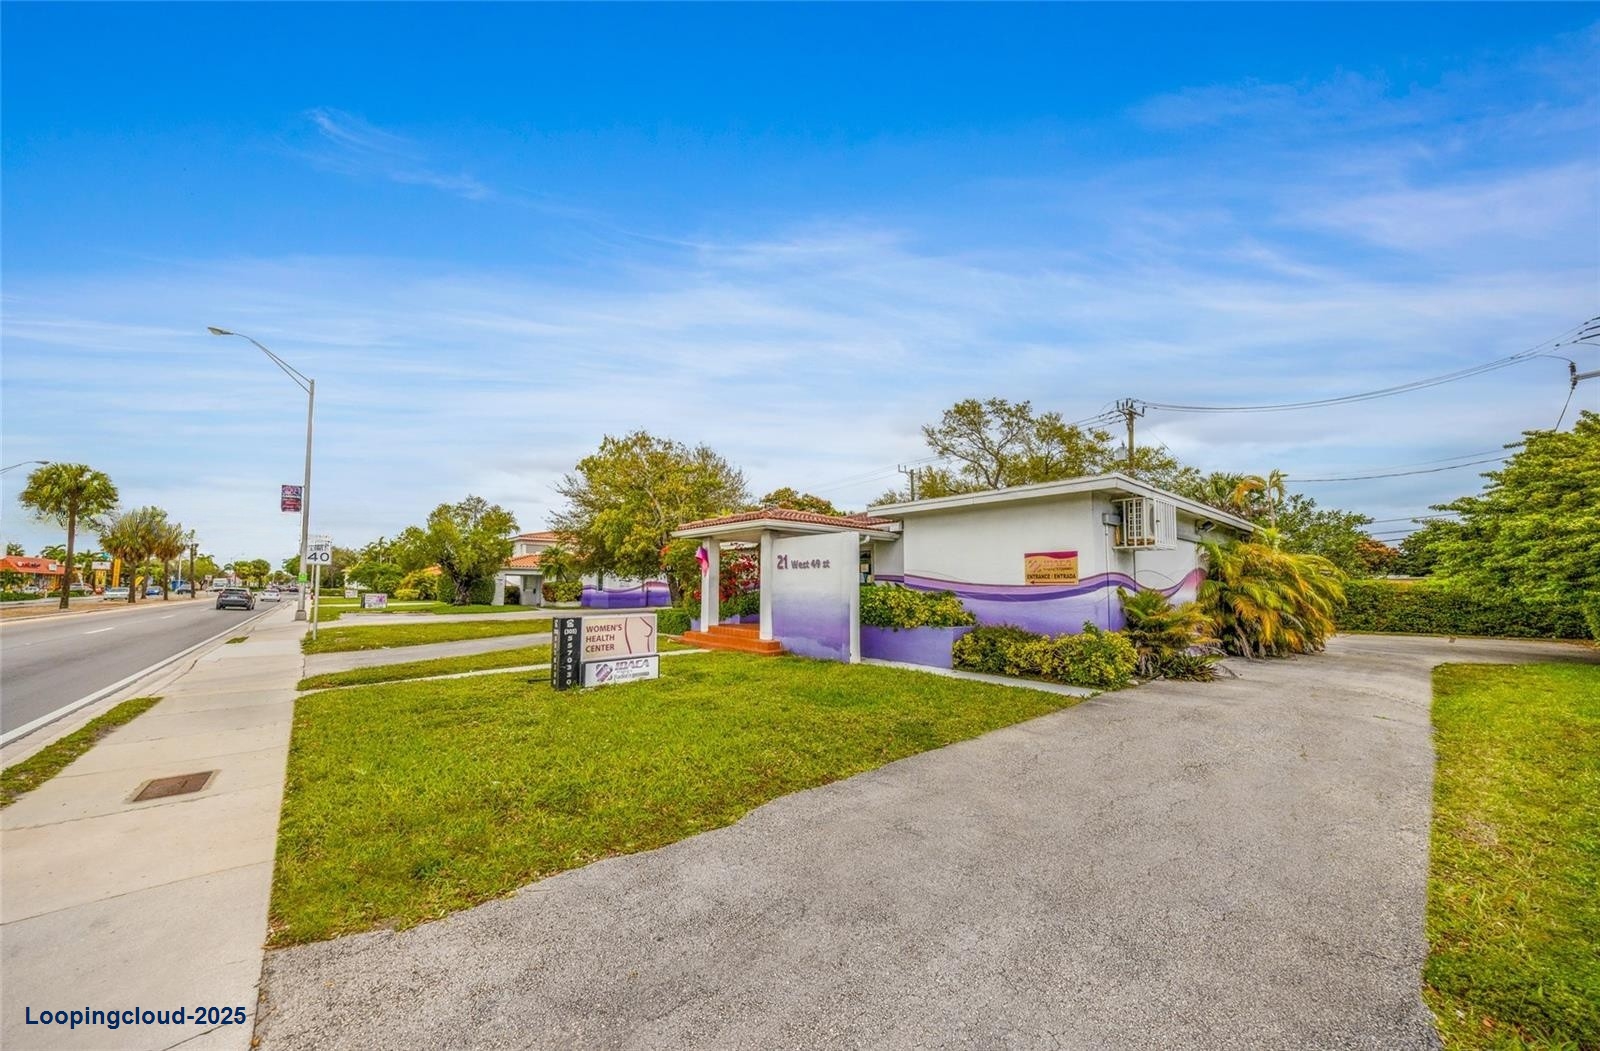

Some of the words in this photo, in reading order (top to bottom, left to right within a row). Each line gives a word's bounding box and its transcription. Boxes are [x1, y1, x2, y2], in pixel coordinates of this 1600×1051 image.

[307, 552, 330, 562] 40
[777, 554, 788, 570] 21
[791, 560, 810, 569] West
[811, 559, 821, 569] 49
[822, 560, 830, 568] st
[586, 624, 623, 633] WOMEN'S
[585, 634, 615, 643] HEALTH
[585, 643, 615, 653] CENTER
